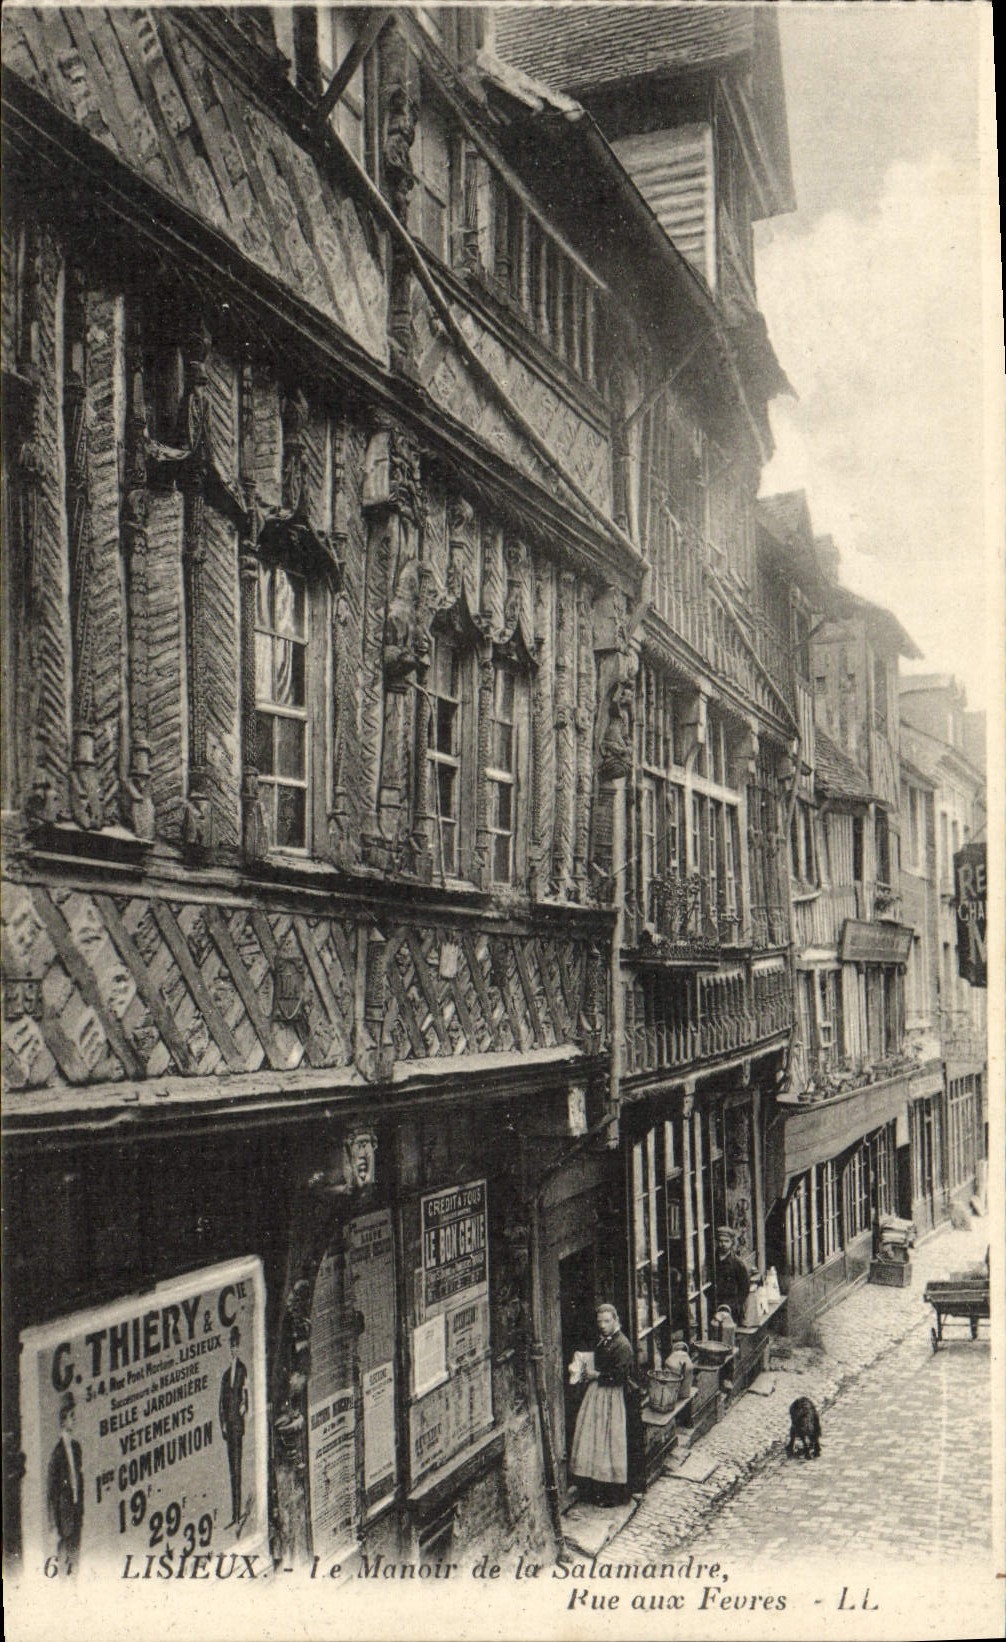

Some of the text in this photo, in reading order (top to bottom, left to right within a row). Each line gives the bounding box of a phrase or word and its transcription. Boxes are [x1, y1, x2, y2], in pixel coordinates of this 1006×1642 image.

[425, 1230, 437, 1268] LE
[439, 1222, 458, 1265] BON
[85, 1297, 201, 1378] THIERY
[202, 1310, 213, 1333] &
[109, 1375, 125, 1393] Rue
[127, 1368, 145, 1386] Pont
[179, 1334, 222, 1363] LISIEUX
[99, 1407, 139, 1438] BELLE
[117, 1420, 213, 1492] COMMUNION
